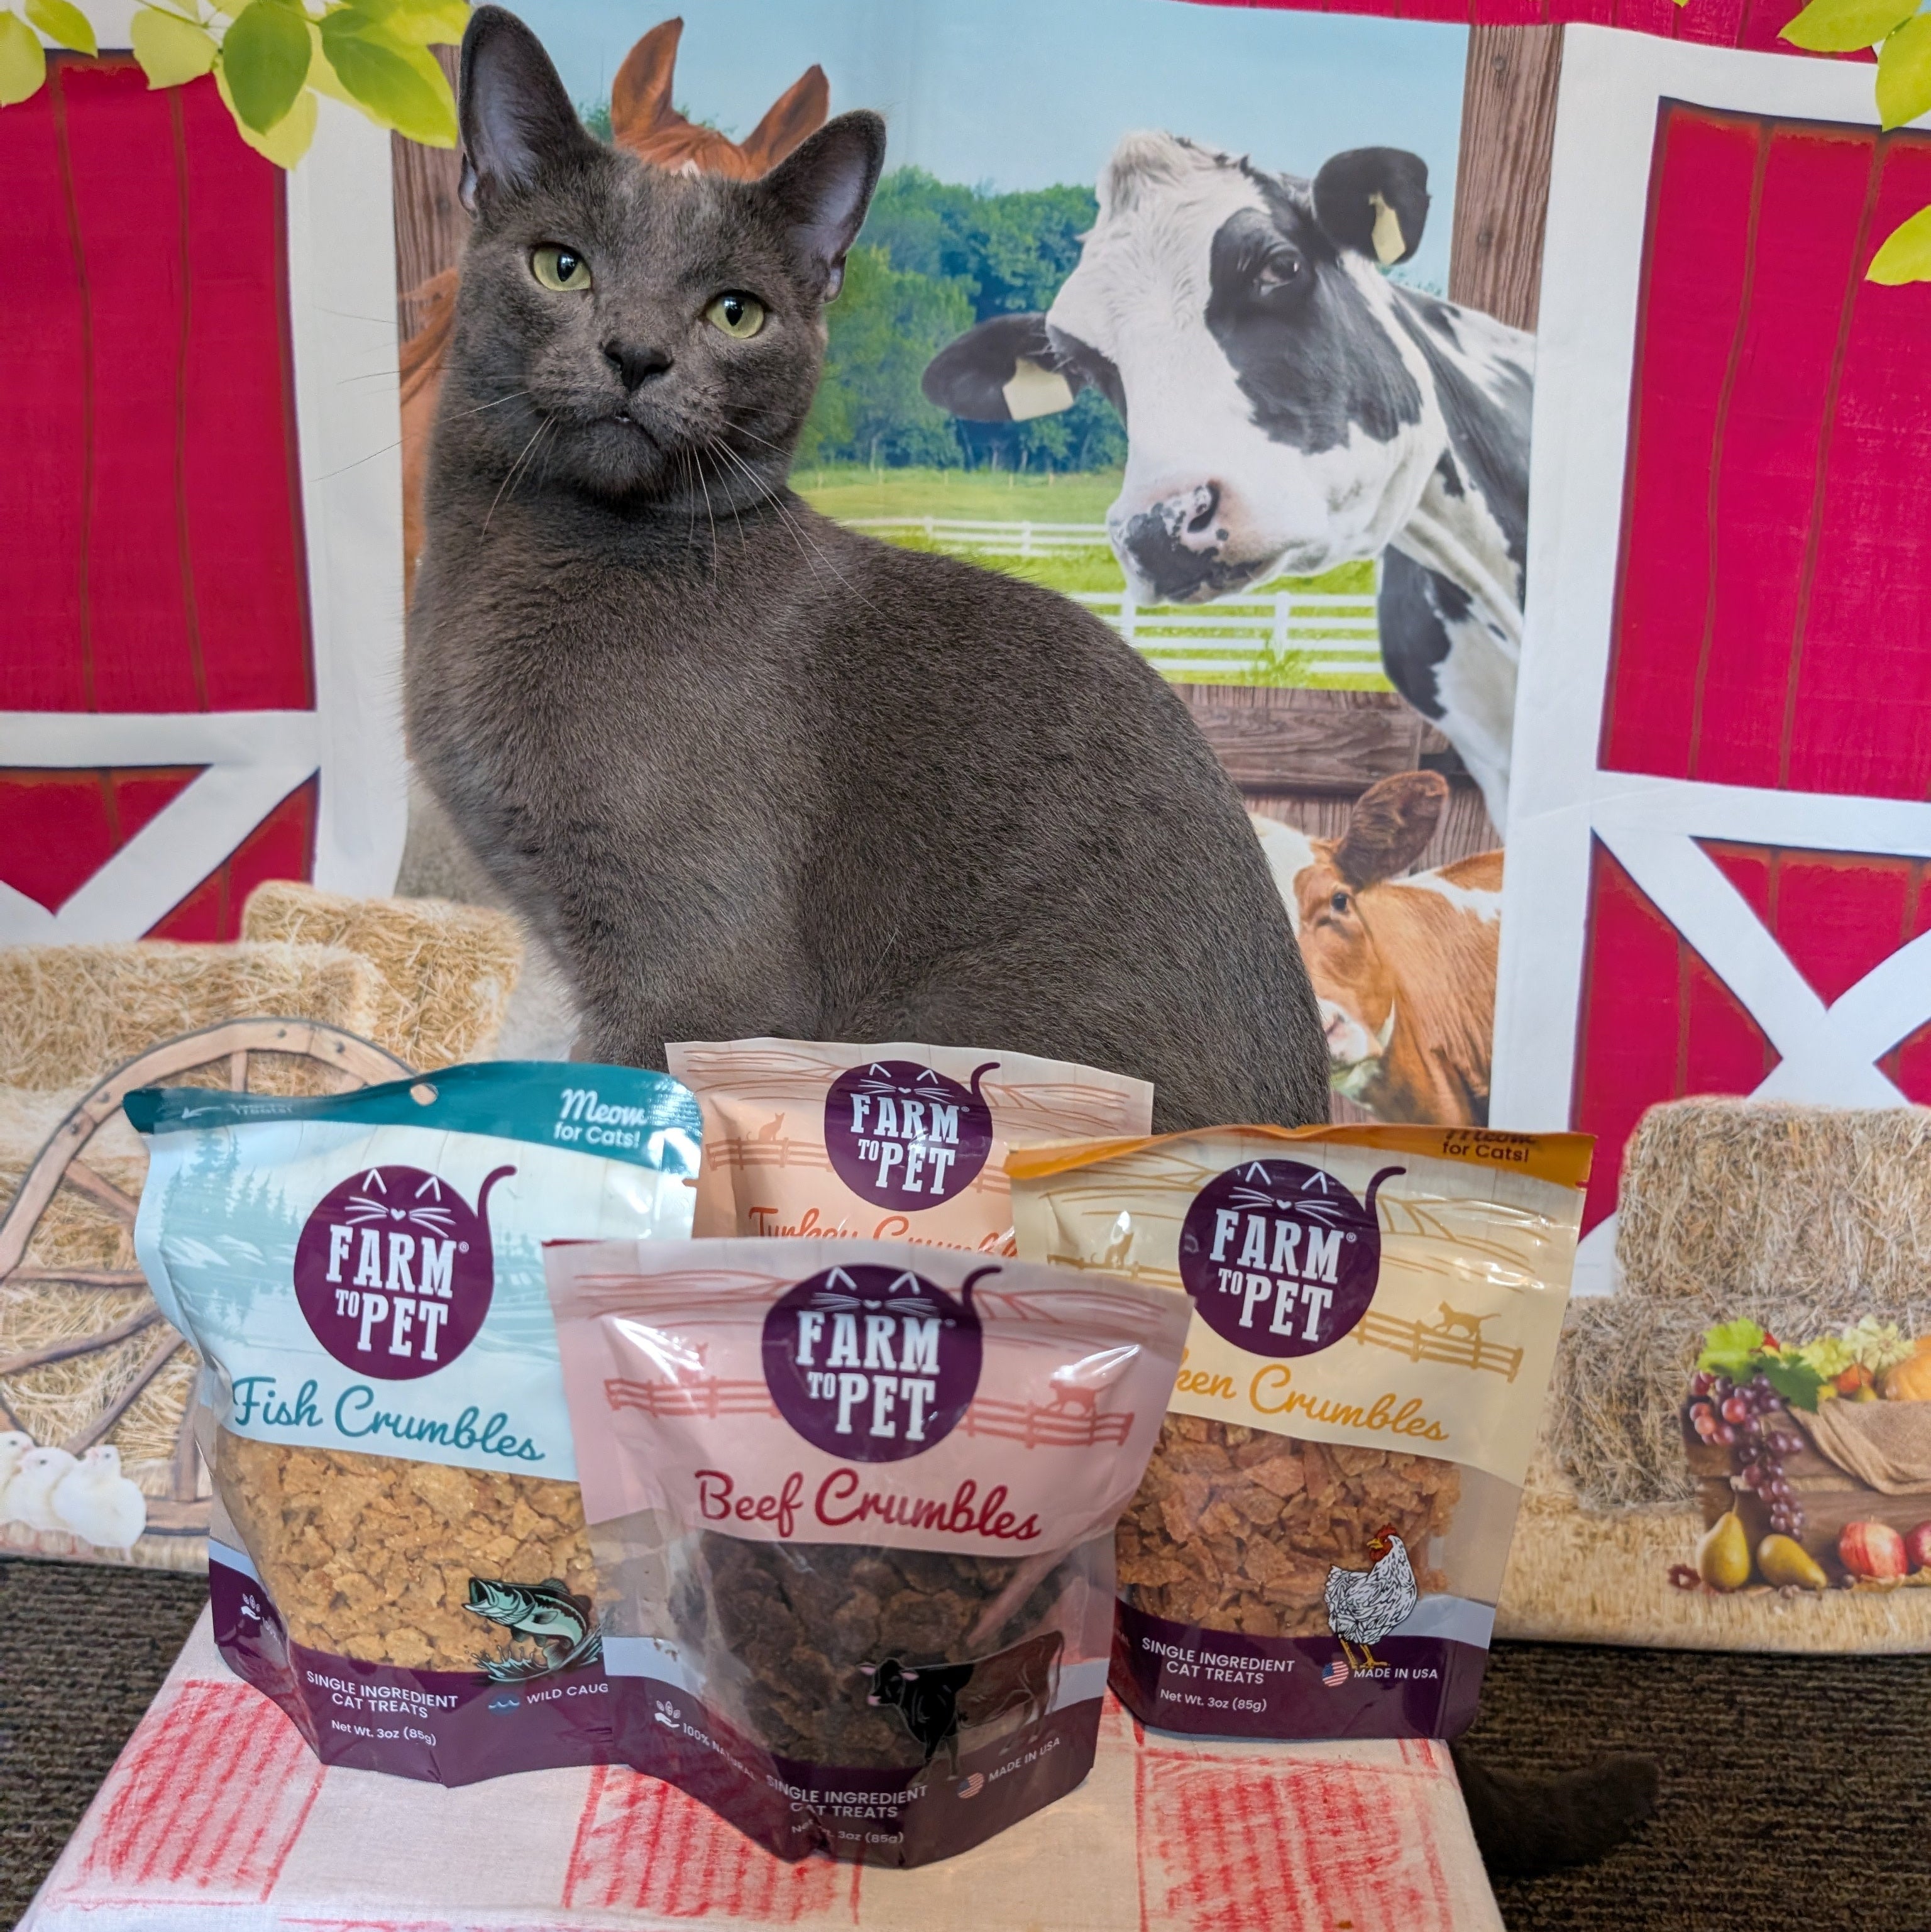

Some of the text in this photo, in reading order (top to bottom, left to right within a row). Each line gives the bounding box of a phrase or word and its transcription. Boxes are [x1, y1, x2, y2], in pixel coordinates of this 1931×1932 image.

[560, 1088, 647, 1126] Meow
[850, 1093, 959, 1144] FARM
[553, 1122, 641, 1149] for Cats!
[1443, 1141, 1529, 1162] for Cats!
[858, 1139, 955, 1195] TO PET
[326, 1223, 457, 1299] FARM
[1209, 1208, 1345, 1284] FARM
[1218, 1267, 1333, 1342] TO PET
[335, 1288, 448, 1362] TO PET
[795, 1310, 942, 1374] FARM
[233, 1376, 546, 1461] Fish Crumbles
[807, 1371, 935, 1441] TO PET
[1249, 1364, 1450, 1441] Crumbles
[694, 1467, 1042, 1540] Beef Crumbles
[1142, 1637, 1195, 1662] SINGLE
[1199, 1652, 1295, 1672] INGREDIENT
[1167, 1661, 1264, 1684] CAT TREATS
[1354, 1668, 1438, 1679] MADE IN USA
[307, 1670, 458, 1708] SINGLE INGREDIENT
[332, 1692, 428, 1718] CAT TREATS
[527, 1683, 608, 1704] WILD CAUG
[1160, 1689, 1267, 1713] Net Wt. 3oz (85g)
[331, 1720, 436, 1746] Net Wt. 3oz (85g)
[683, 1723, 710, 1747] 100%
[989, 1737, 1060, 1782] MADE IN USA
[766, 1775, 928, 1805] SINGLE INGREDIENT
[832, 1805, 898, 1818] TREATS
[838, 1831, 861, 1841] 3oz
[864, 1831, 904, 1844] (85g)
